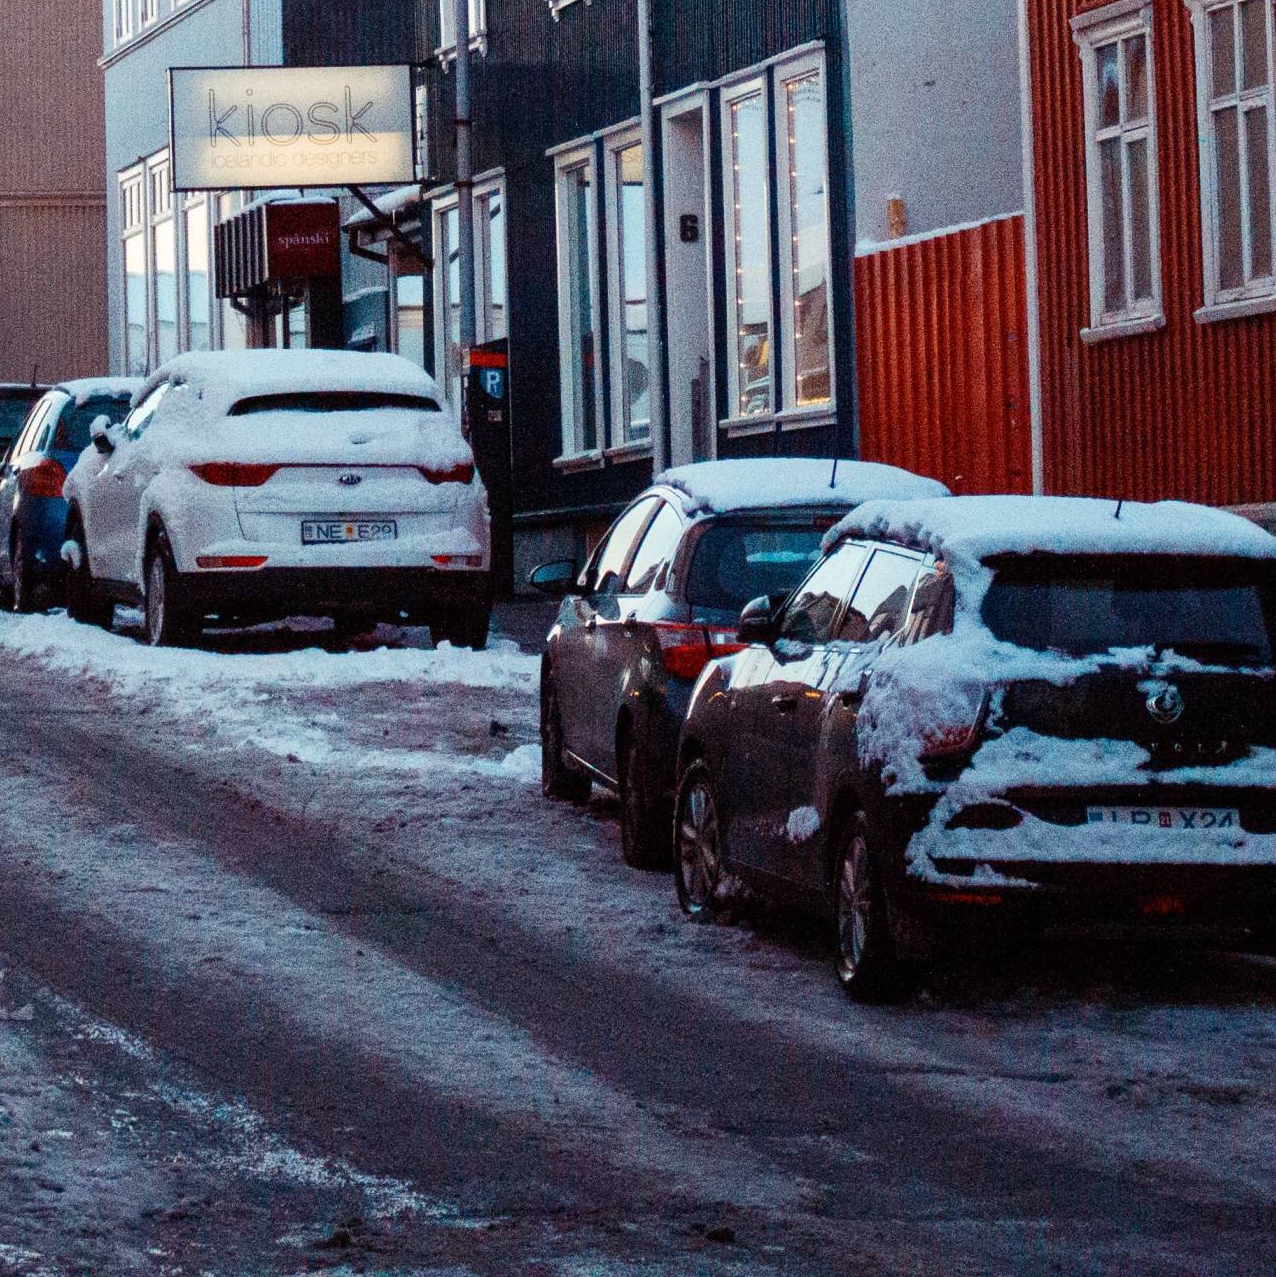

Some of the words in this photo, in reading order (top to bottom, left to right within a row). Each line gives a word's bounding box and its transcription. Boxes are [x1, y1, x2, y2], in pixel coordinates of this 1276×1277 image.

[208, 84, 379, 148] kiosk
[210, 148, 288, 169] icelandic
[292, 147, 379, 168] designers
[679, 214, 699, 243] 6
[316, 525, 342, 539] NE
